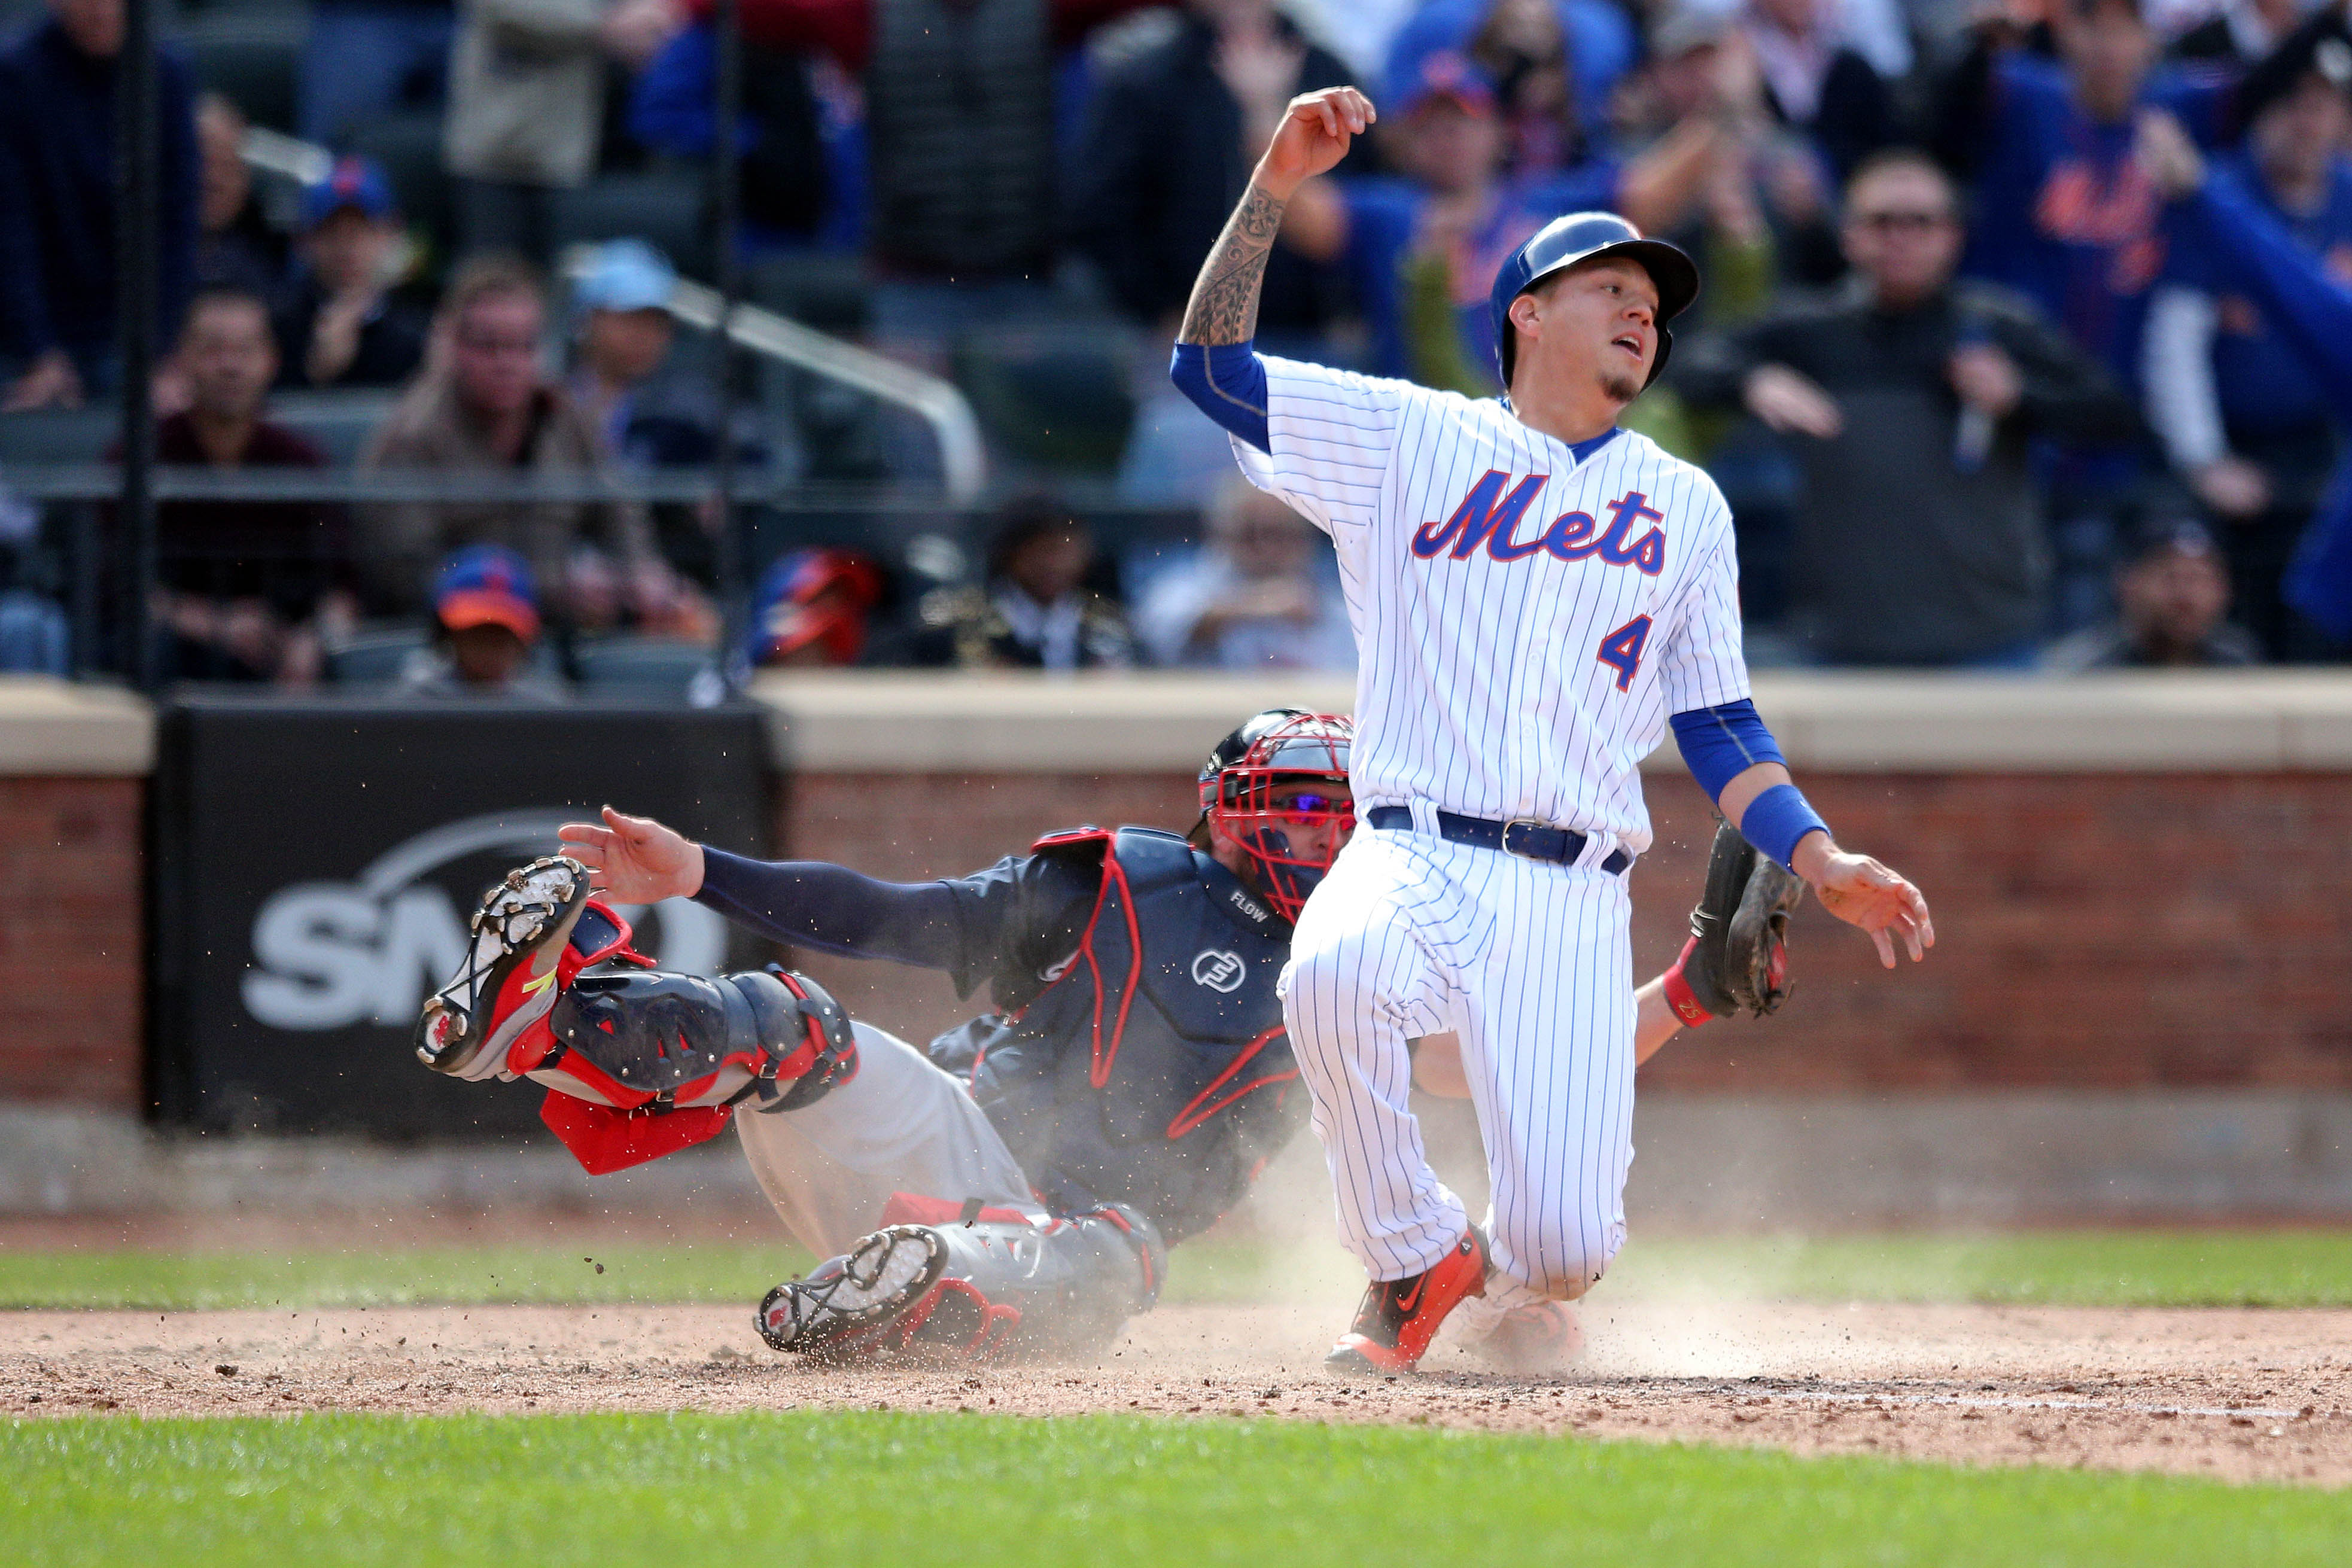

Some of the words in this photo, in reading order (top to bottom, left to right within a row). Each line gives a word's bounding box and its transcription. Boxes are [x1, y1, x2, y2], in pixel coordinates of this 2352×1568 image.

[1411, 469, 1666, 576] Mets
[1597, 613, 1653, 693] 4
[1230, 890, 1269, 923] FLOW
[1678, 999, 1701, 1019] 25
